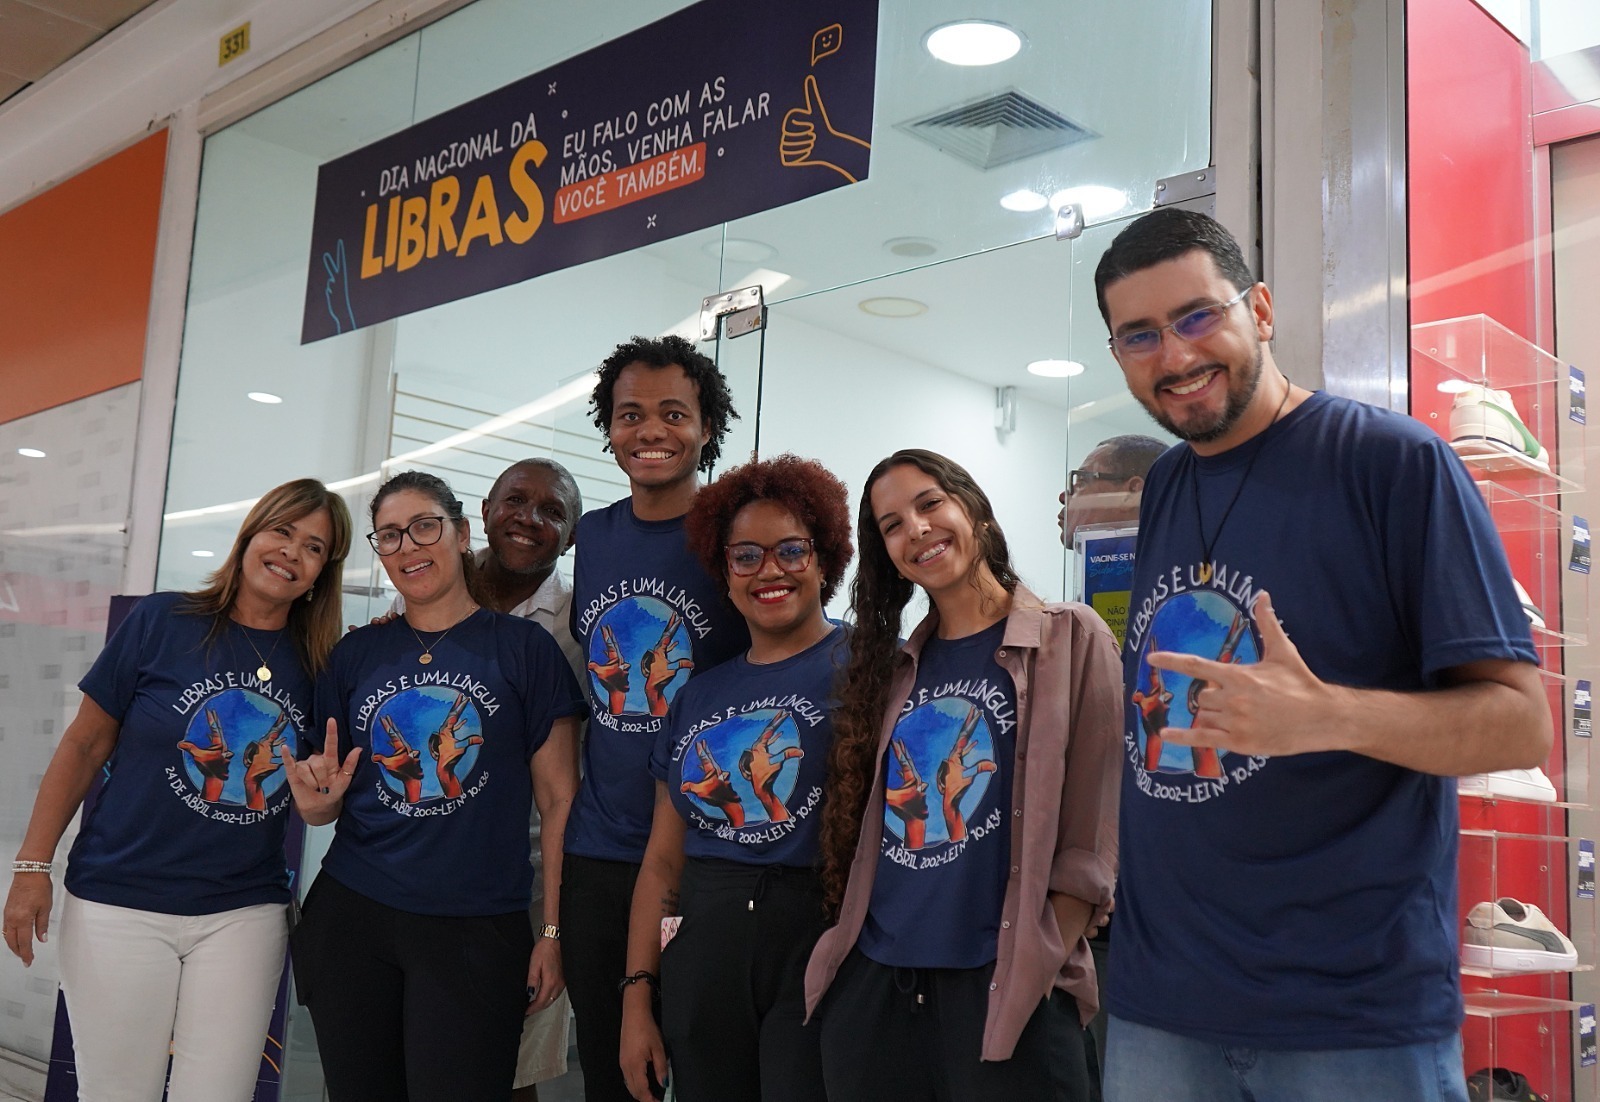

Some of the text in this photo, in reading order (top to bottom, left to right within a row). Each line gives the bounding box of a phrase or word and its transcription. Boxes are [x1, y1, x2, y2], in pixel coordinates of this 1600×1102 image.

[223, 29, 246, 60] 331
[560, 92, 770, 188] MÃOS, VENHA FALAR
[563, 76, 726, 159] EU FALO COM AS
[379, 112, 537, 197] DIA NACIONAL DA
[559, 150, 702, 217] VOCÊ TAMBÉM.
[360, 139, 548, 280] LIBRAS
[1090, 553, 1128, 564] VACINE-SE
[578, 577, 713, 640] LIBRAS É UMA LÍNGUA
[1107, 605, 1126, 616] NÃO
[1130, 575, 1168, 652] LIBRAS
[1172, 565, 1186, 593] É
[172, 671, 306, 732] LIBRAS É UMA LÍNGU
[355, 670, 501, 732] LIBRAS É UMA LÍNGUA
[596, 710, 619, 731] ABRIL
[672, 694, 825, 762] LIBRAS É UMA LÍNGUA
[918, 687, 929, 706] É
[933, 679, 969, 698] UMA
[968, 679, 1017, 735] LÍNGUA
[165, 766, 175, 780] 24
[170, 779, 182, 796] DE
[181, 794, 209, 818] ABRIL
[378, 790, 391, 806] DE
[467, 770, 489, 798] 10.436
[1231, 754, 1269, 785] 10.43
[699, 818, 714, 830] DE
[796, 786, 823, 819] 10.436
[885, 845, 918, 870] ABRIL
